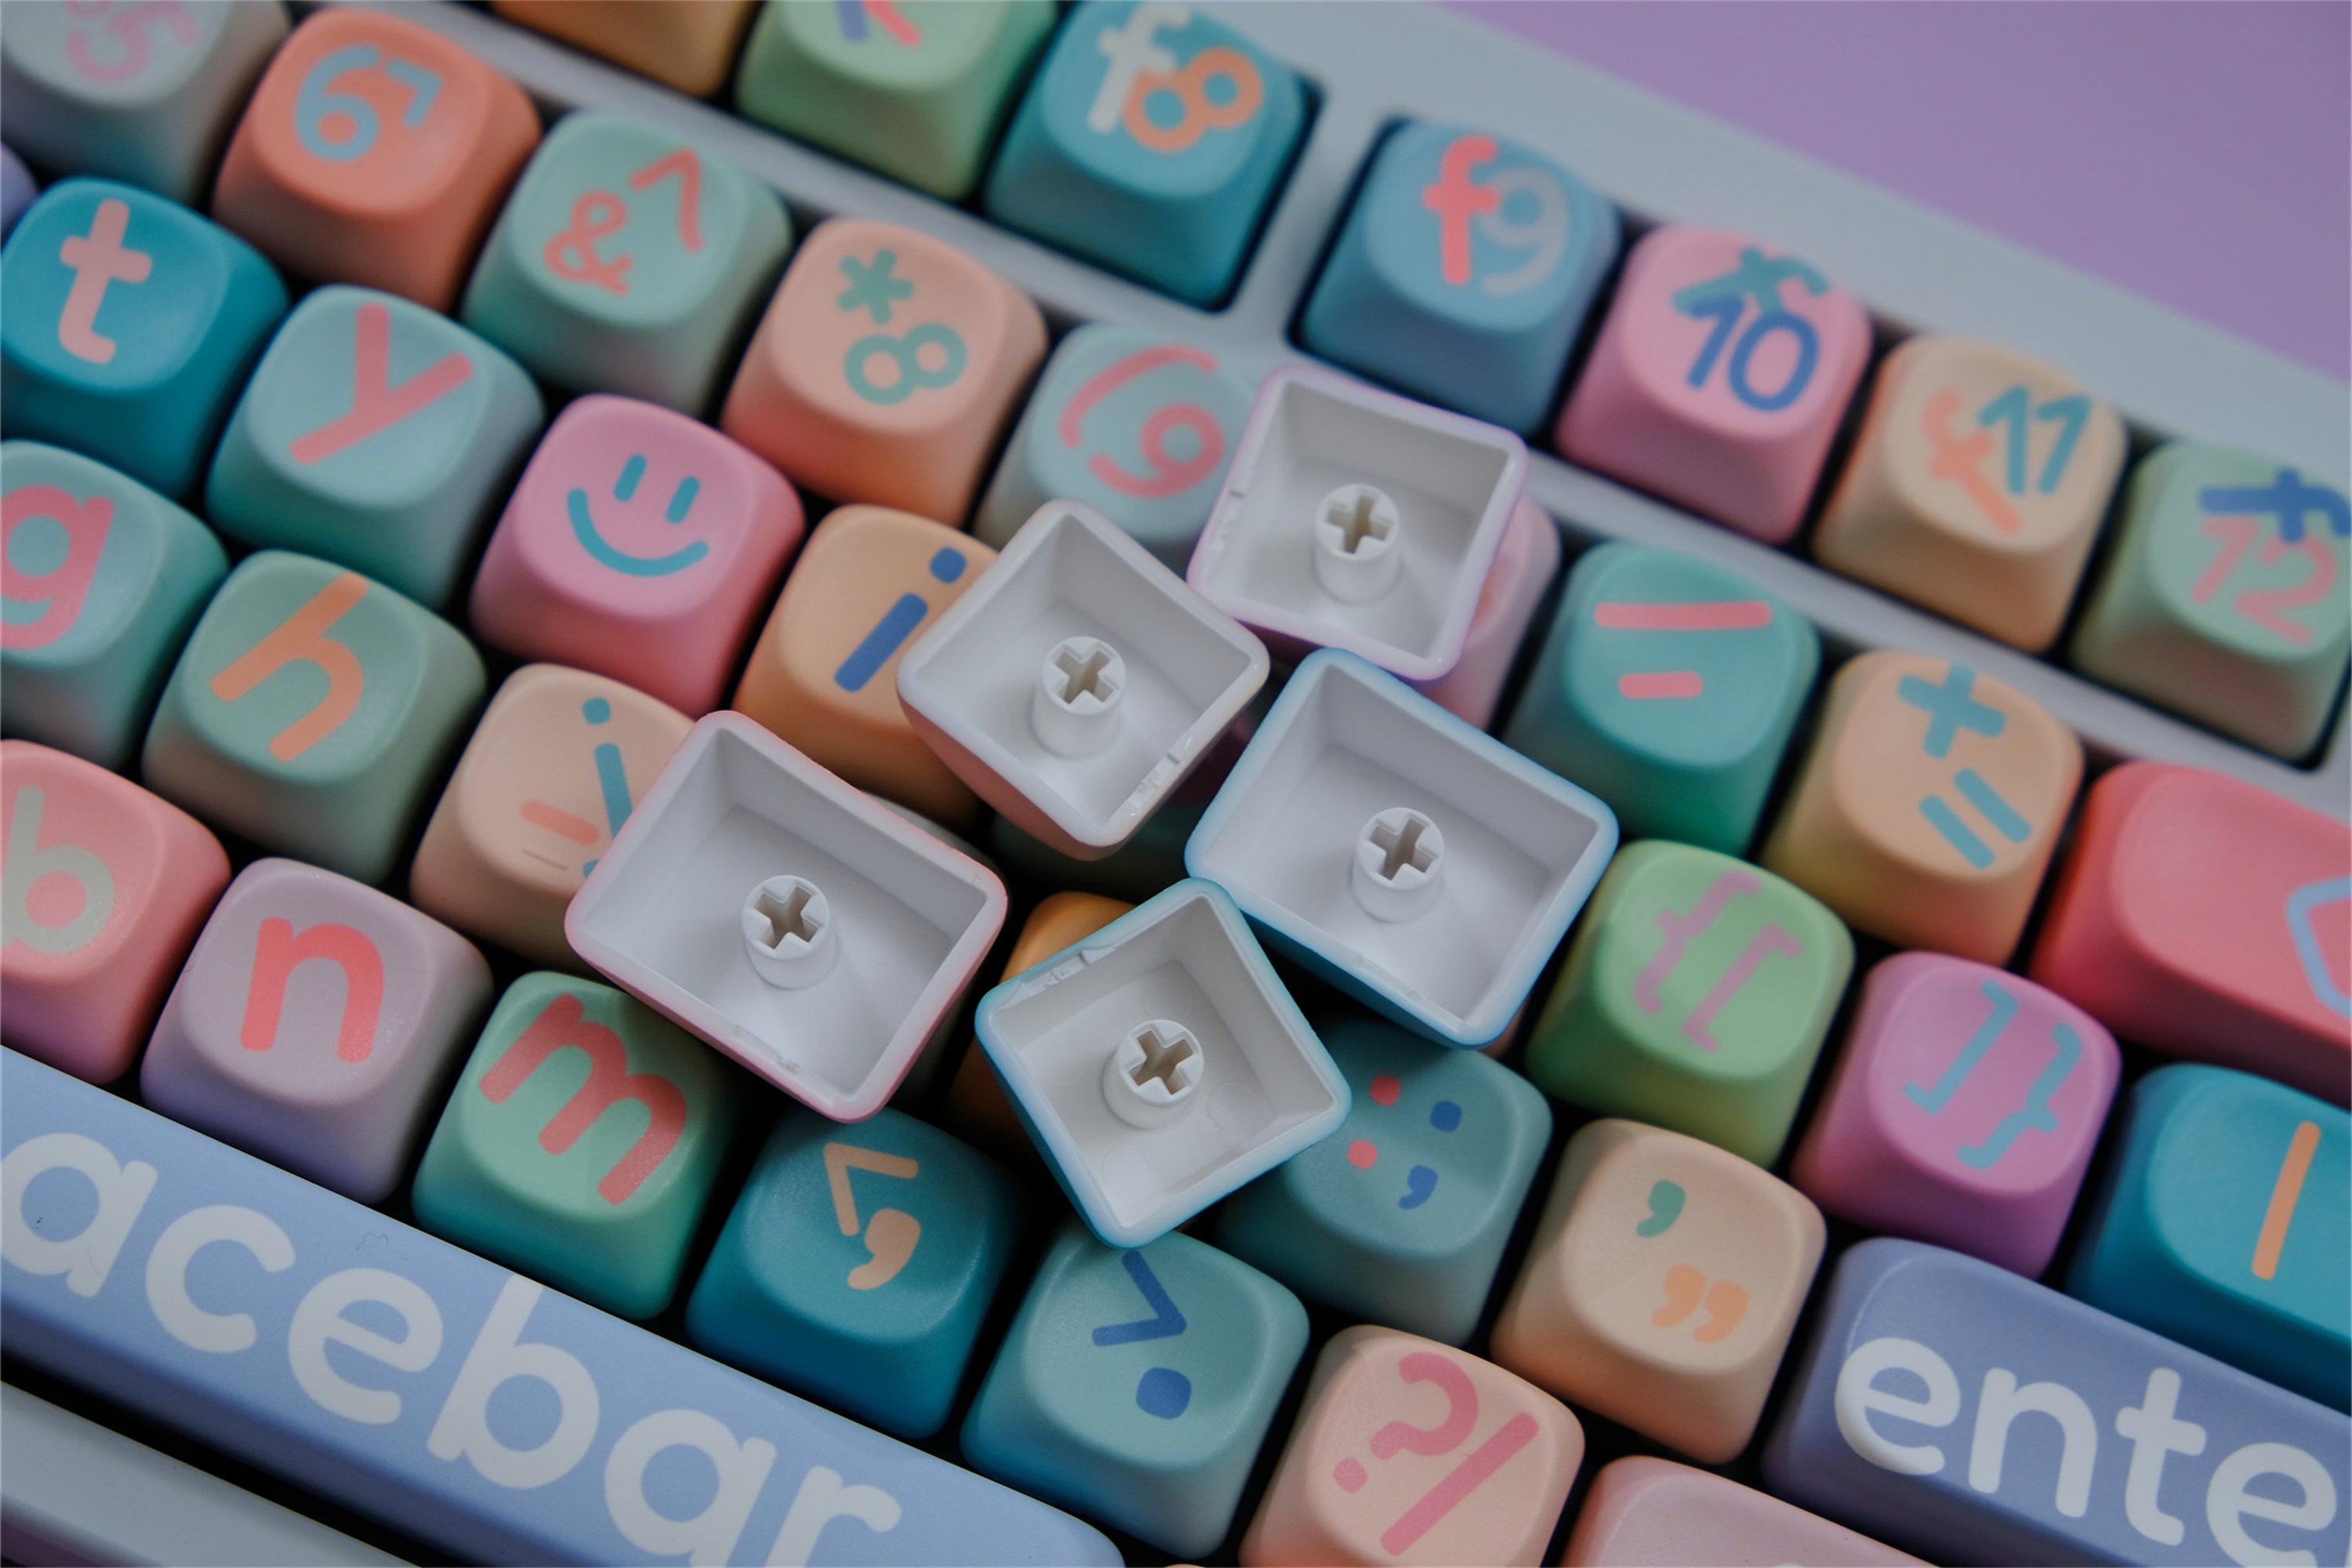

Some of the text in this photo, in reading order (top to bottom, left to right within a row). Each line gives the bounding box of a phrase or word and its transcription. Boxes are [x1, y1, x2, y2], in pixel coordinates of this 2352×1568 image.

[59, 199, 152, 364] t
[290, 303, 473, 464] y
[0, 484, 115, 649] g
[210, 571, 368, 762] h
[0, 784, 115, 954] b
[240, 917, 384, 1063] n
[477, 993, 688, 1206] m
[0, 1132, 902, 1568] acebar
[1835, 1337, 2352, 1568] ente
